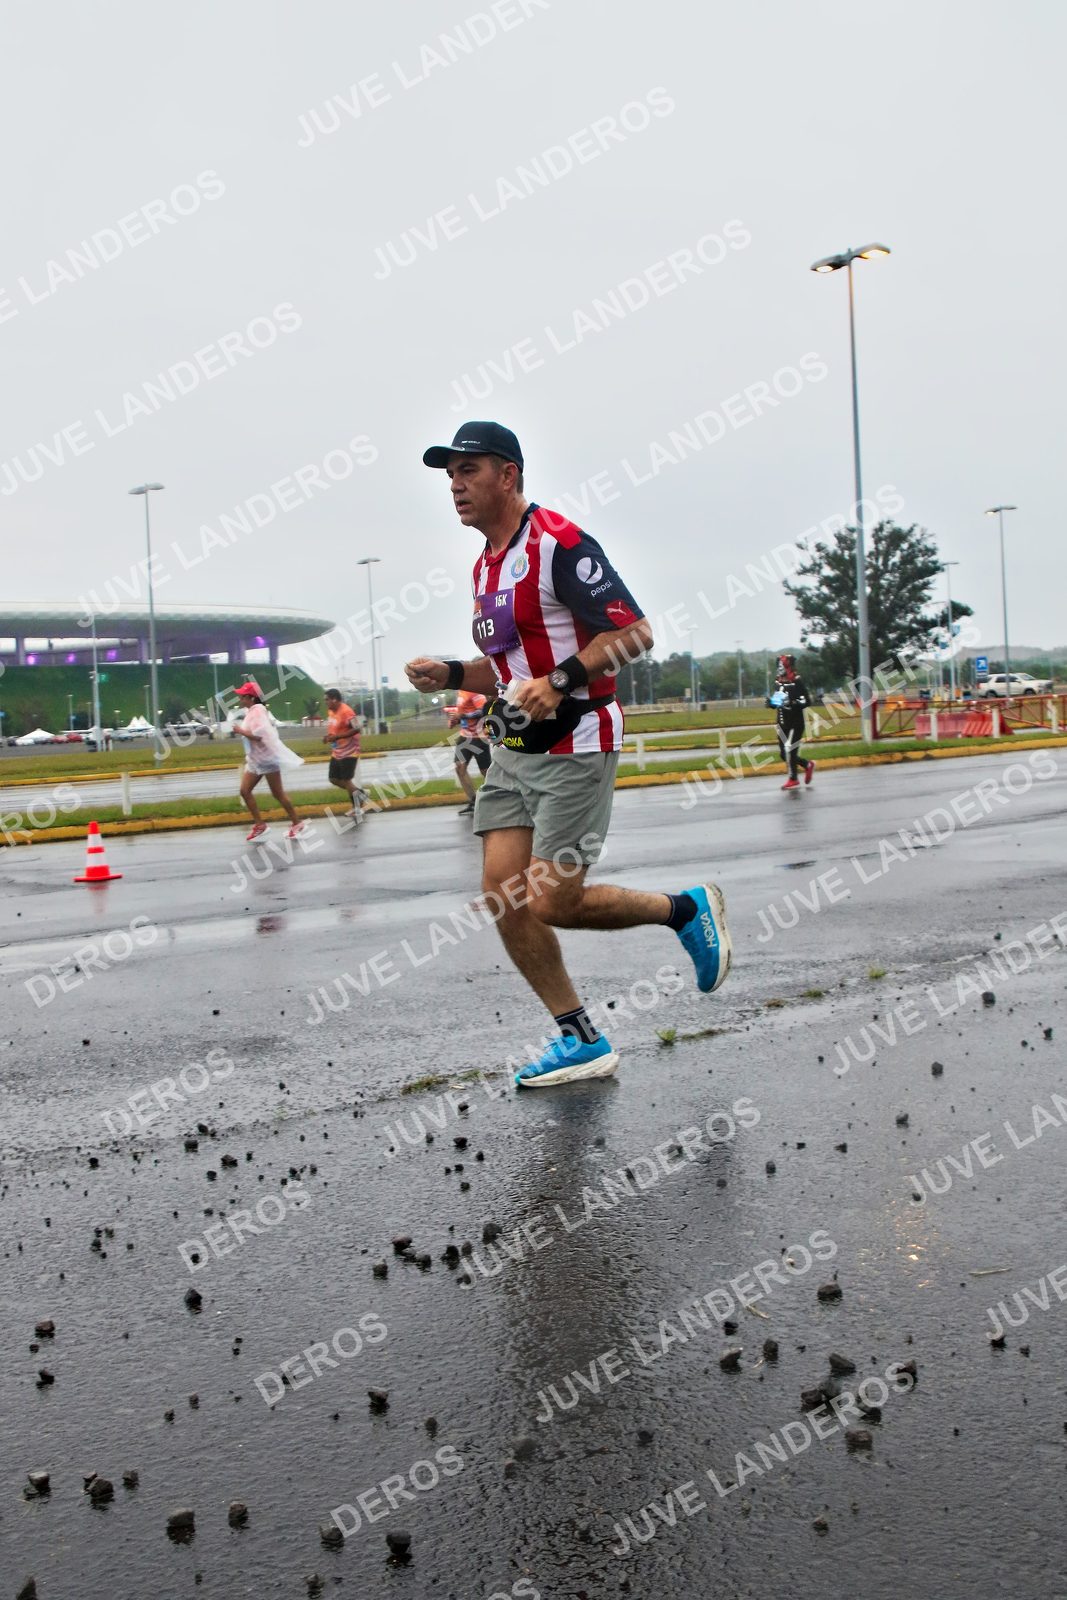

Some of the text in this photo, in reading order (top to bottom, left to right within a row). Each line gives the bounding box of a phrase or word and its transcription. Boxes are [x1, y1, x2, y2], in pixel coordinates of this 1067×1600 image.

[590, 580, 613, 597] pepsi
[477, 618, 495, 639] 113
[700, 911, 718, 948] HOKA
